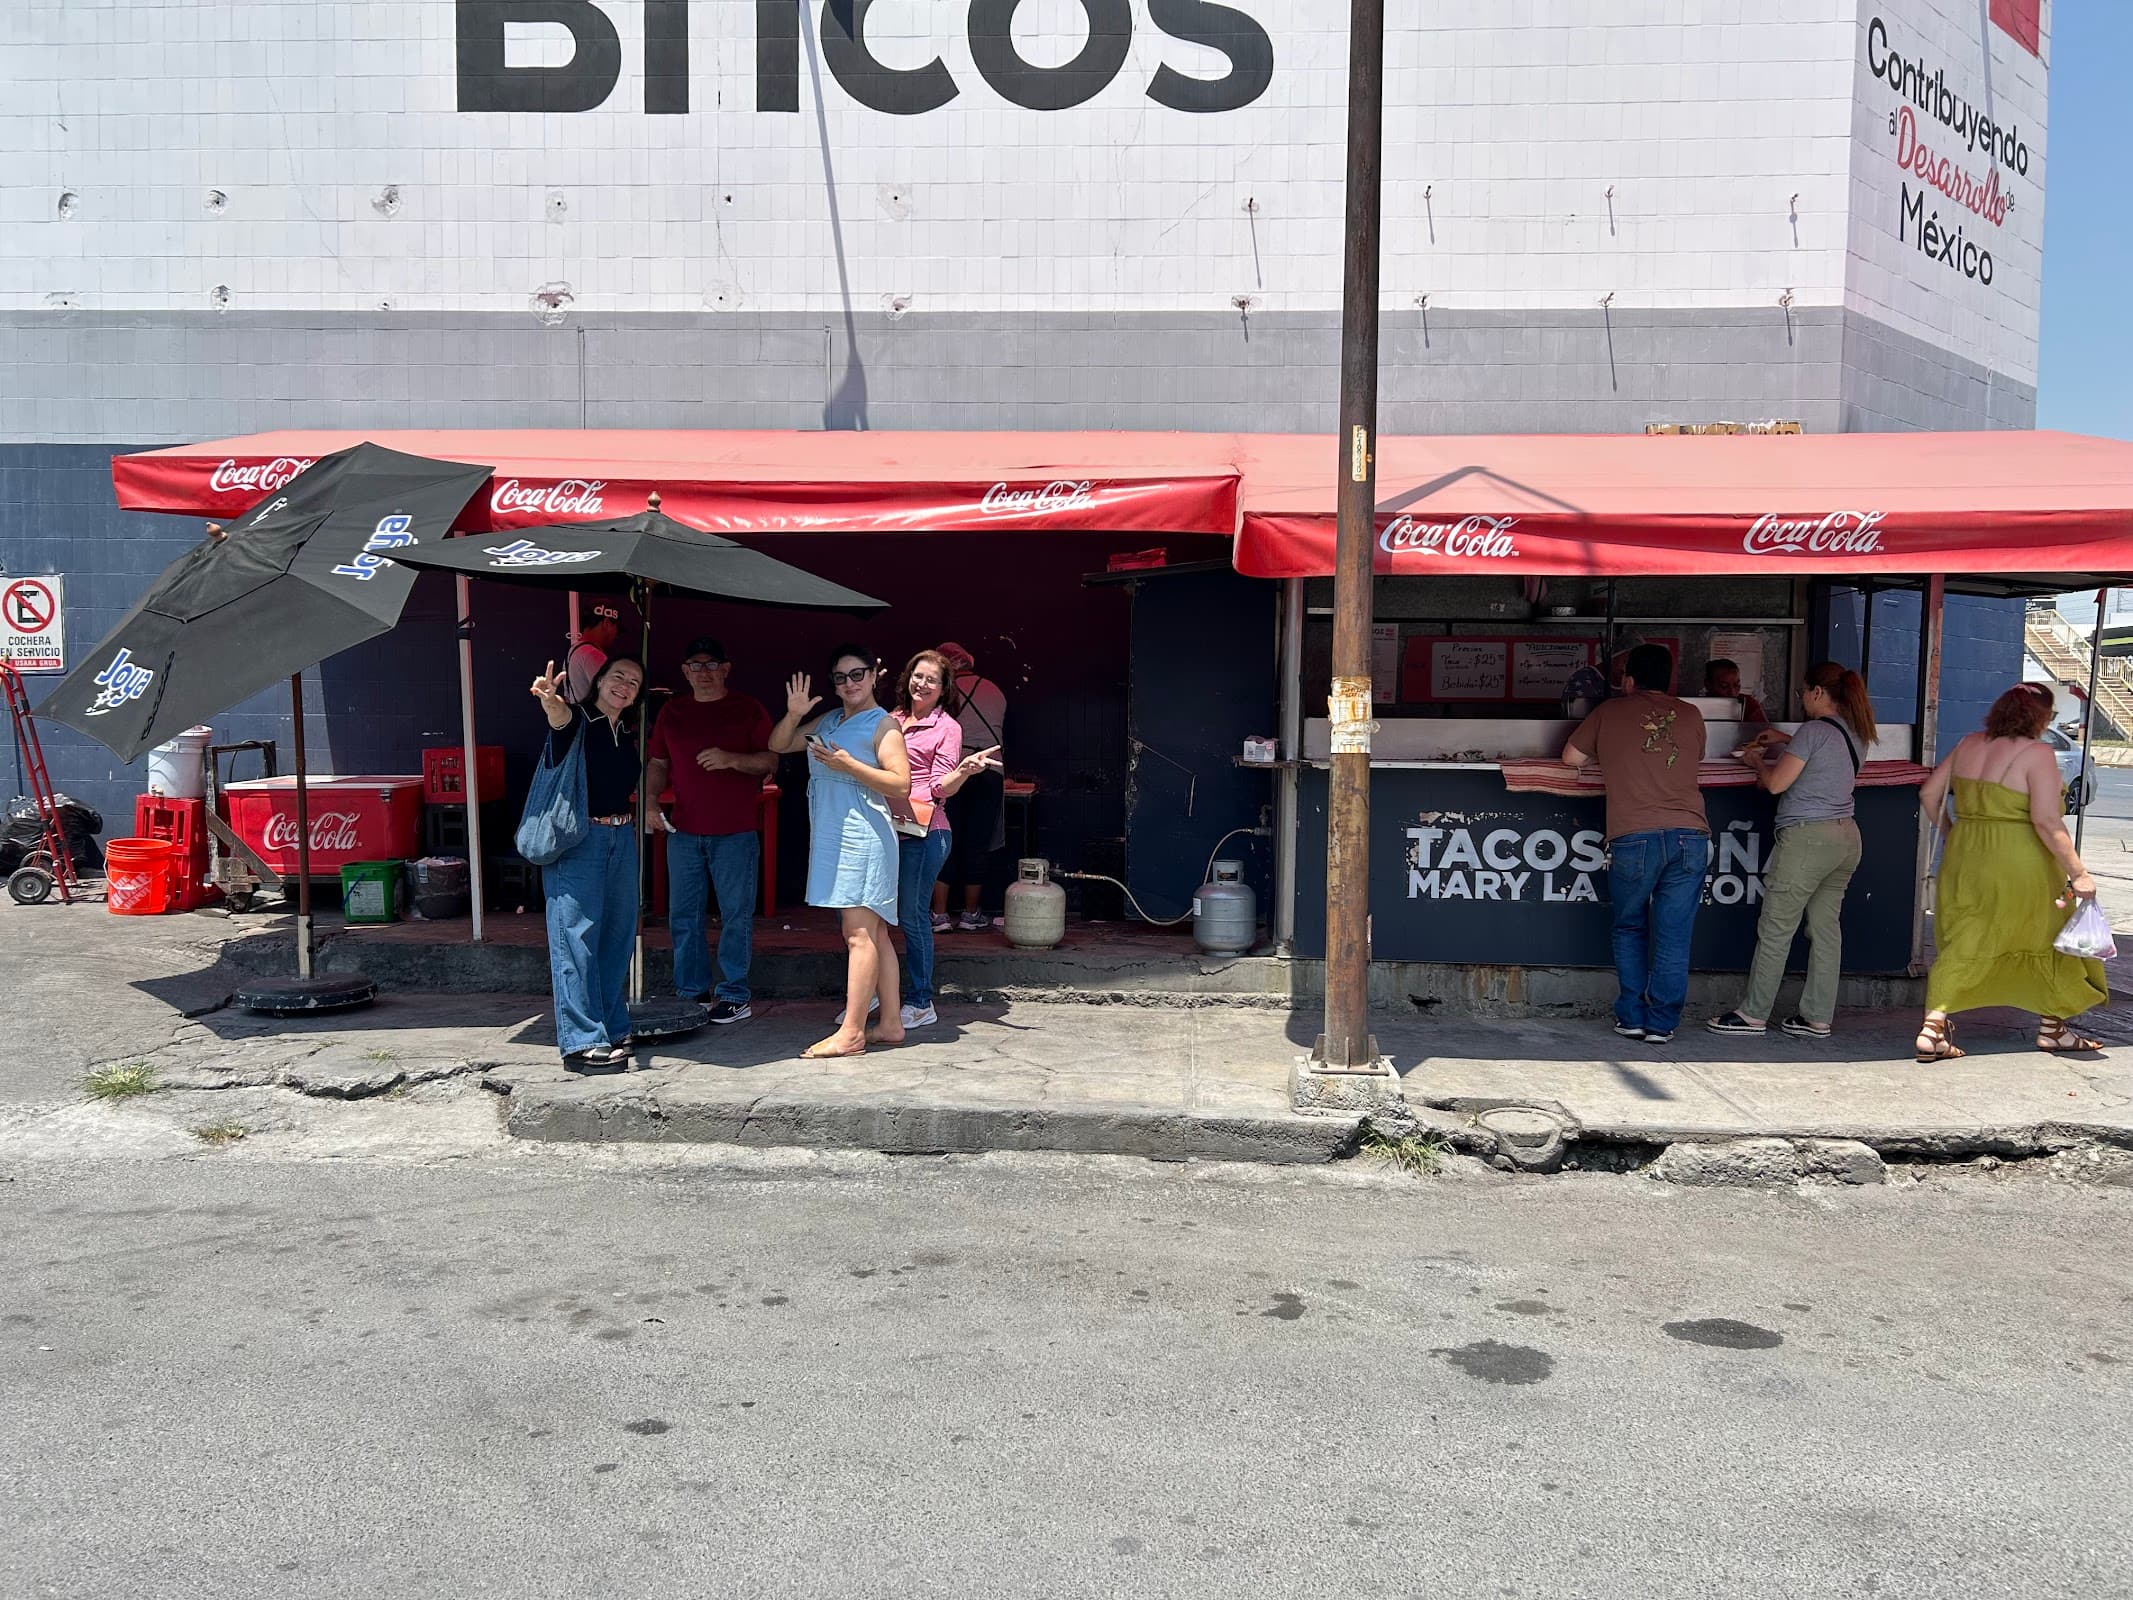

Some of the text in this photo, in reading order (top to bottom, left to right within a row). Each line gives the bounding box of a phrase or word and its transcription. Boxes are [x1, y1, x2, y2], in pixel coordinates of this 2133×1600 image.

[1868, 17, 2028, 176] Contribuyendo
[1889, 106, 2015, 227] al Desarrollo de
[1900, 182, 1993, 285] México
[210, 458, 317, 492] Coca-Col
[490, 480, 607, 514] Coca-Cola
[980, 480, 1096, 513] Coca-Cola
[1379, 514, 1520, 557] Coca-Cola
[1743, 510, 1888, 554] Coca-Cola
[8, 636, 51, 646] COCHERA
[17, 647, 61, 657] SERVICIO
[93, 647, 154, 708] Joya
[263, 812, 361, 851] Coc-Cola
[1406, 828, 1605, 872] TACOS
[1407, 870, 1600, 902] MARY LA
